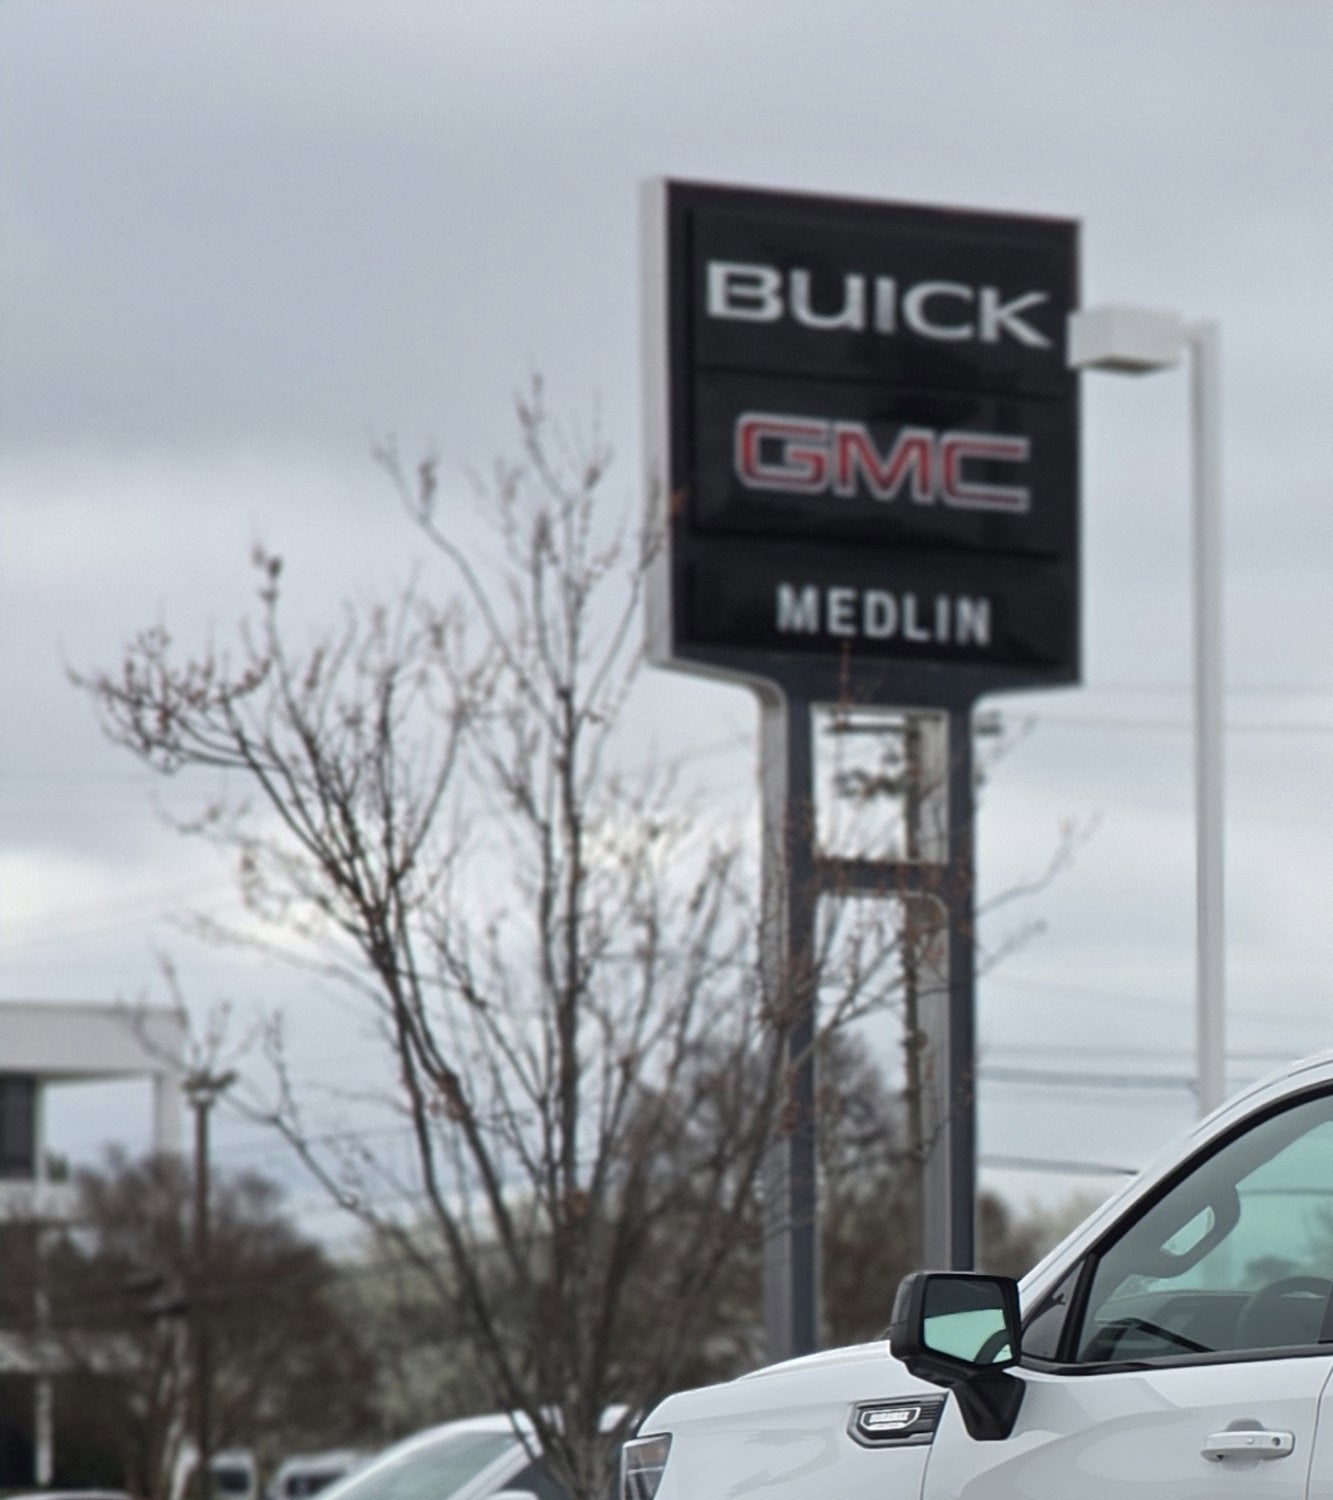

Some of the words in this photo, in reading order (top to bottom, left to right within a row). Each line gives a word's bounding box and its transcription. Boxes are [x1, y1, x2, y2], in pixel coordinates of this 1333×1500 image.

[707, 260, 1052, 349] BUICK
[735, 411, 1030, 513] GMC
[776, 582, 991, 646] MEDLIN
